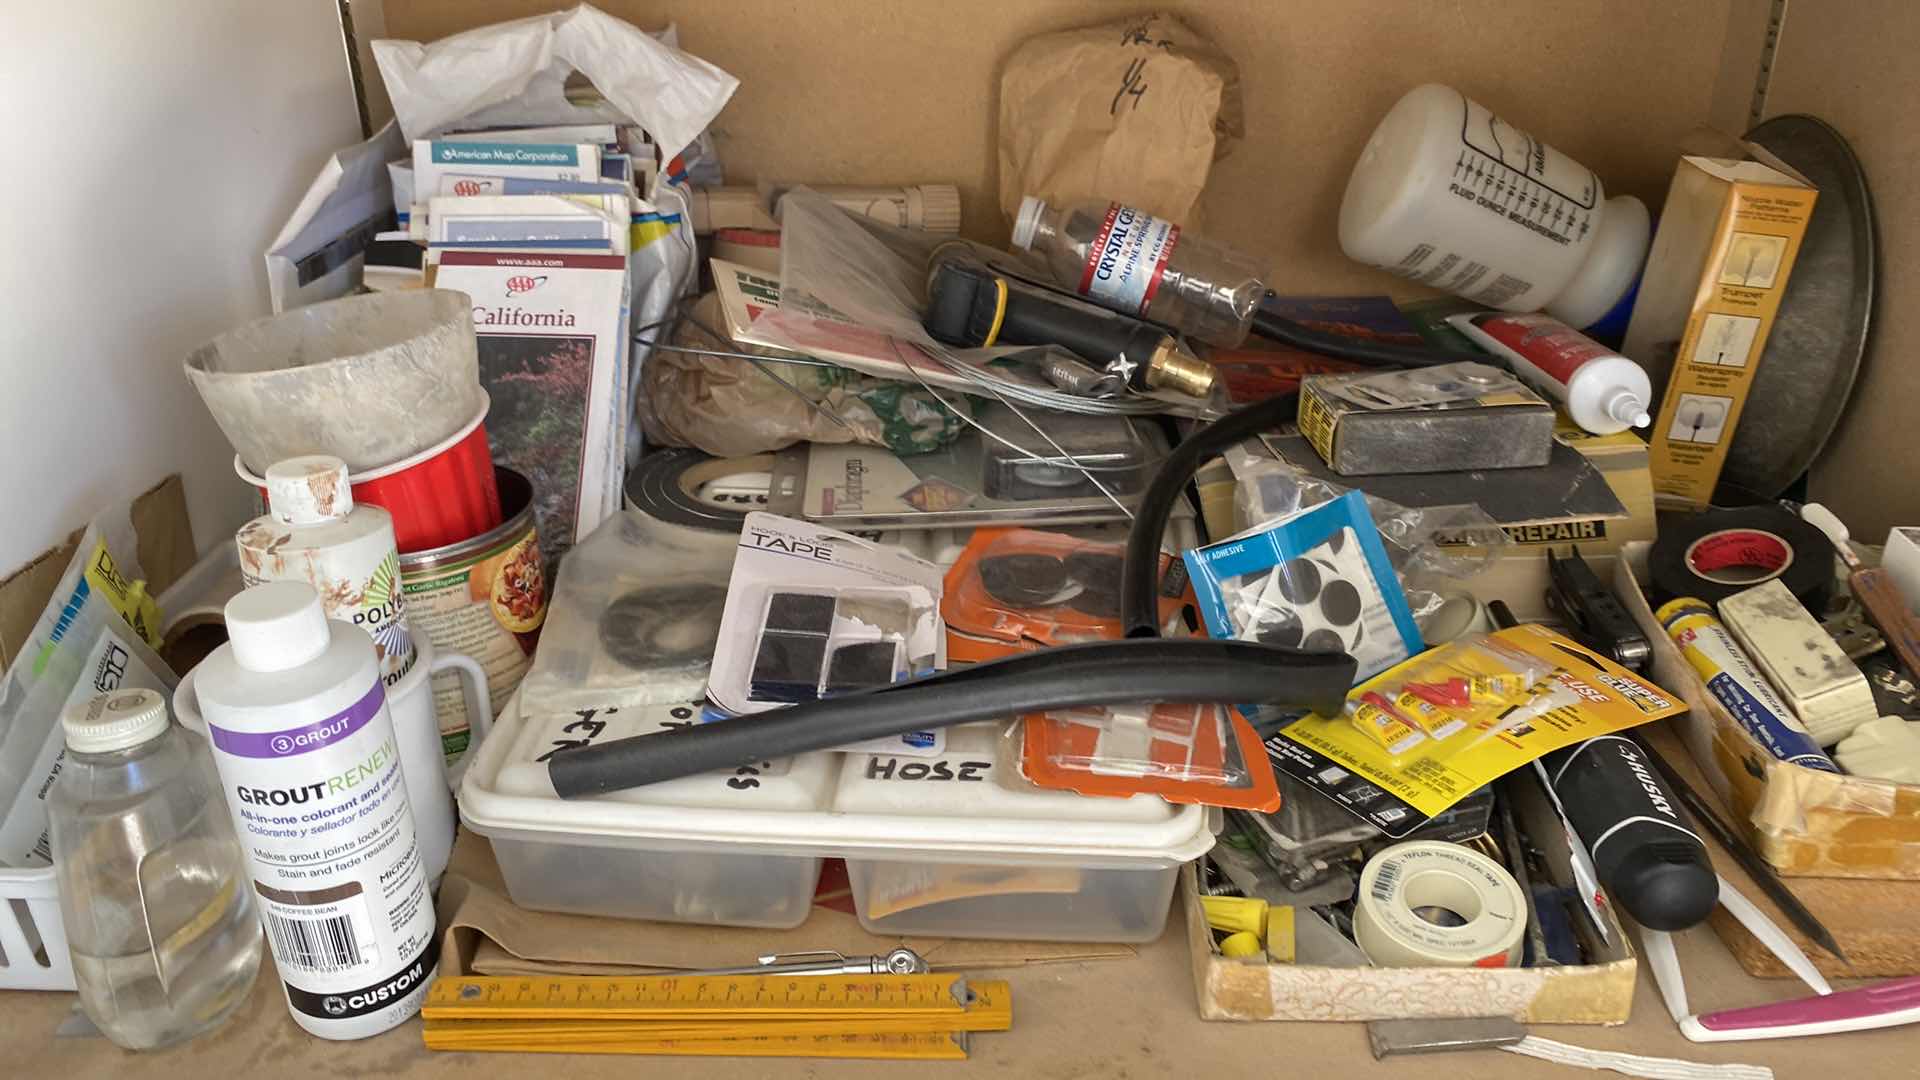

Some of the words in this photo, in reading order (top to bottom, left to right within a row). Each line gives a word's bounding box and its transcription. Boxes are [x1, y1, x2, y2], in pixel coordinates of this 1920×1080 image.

[451, 149, 492, 161] American
[494, 150, 515, 163] Map
[515, 151, 569, 163] Corporation
[1449, 182, 1477, 201] FLUID
[1476, 195, 1507, 216] OUNCE
[1507, 211, 1572, 246] MEASUREMENT
[496, 257, 564, 268] www.aaa.com
[1096, 226, 1130, 281] CRYSTAL
[472, 306, 576, 327] California
[750, 532, 833, 561] TAPE
[1510, 521, 1597, 543] REPAIR
[1211, 543, 1247, 561] ADHESIVE
[1597, 673, 1639, 698] GLUE
[1618, 675, 1671, 708] SUPER
[295, 718, 350, 747] GROUT
[865, 756, 992, 782] HOSE
[240, 808, 298, 826] All-in-one
[301, 796, 358, 824] colorant
[360, 782, 381, 803] and
[1627, 760, 1678, 819] HUSKY
[247, 823, 298, 838] Colorante
[299, 827, 308, 839] y
[310, 813, 357, 835] sellador
[359, 800, 381, 818] todo
[253, 847, 288, 863] Makes
[289, 852, 321, 864] grout
[323, 841, 356, 861] joints
[356, 827, 379, 845] look
[380, 816, 396, 830] like
[277, 869, 307, 880] Stain
[309, 864, 333, 878] and
[334, 857, 362, 873] fade
[363, 828, 401, 861] resistant
[1402, 851, 1434, 861] TEFLON
[1435, 852, 1467, 866] THREAD
[1467, 861, 1483, 875] SEAL
[1484, 872, 1502, 888] TAPE
[314, 905, 338, 914] BEAN
[348, 962, 424, 1010] CUSTOM
